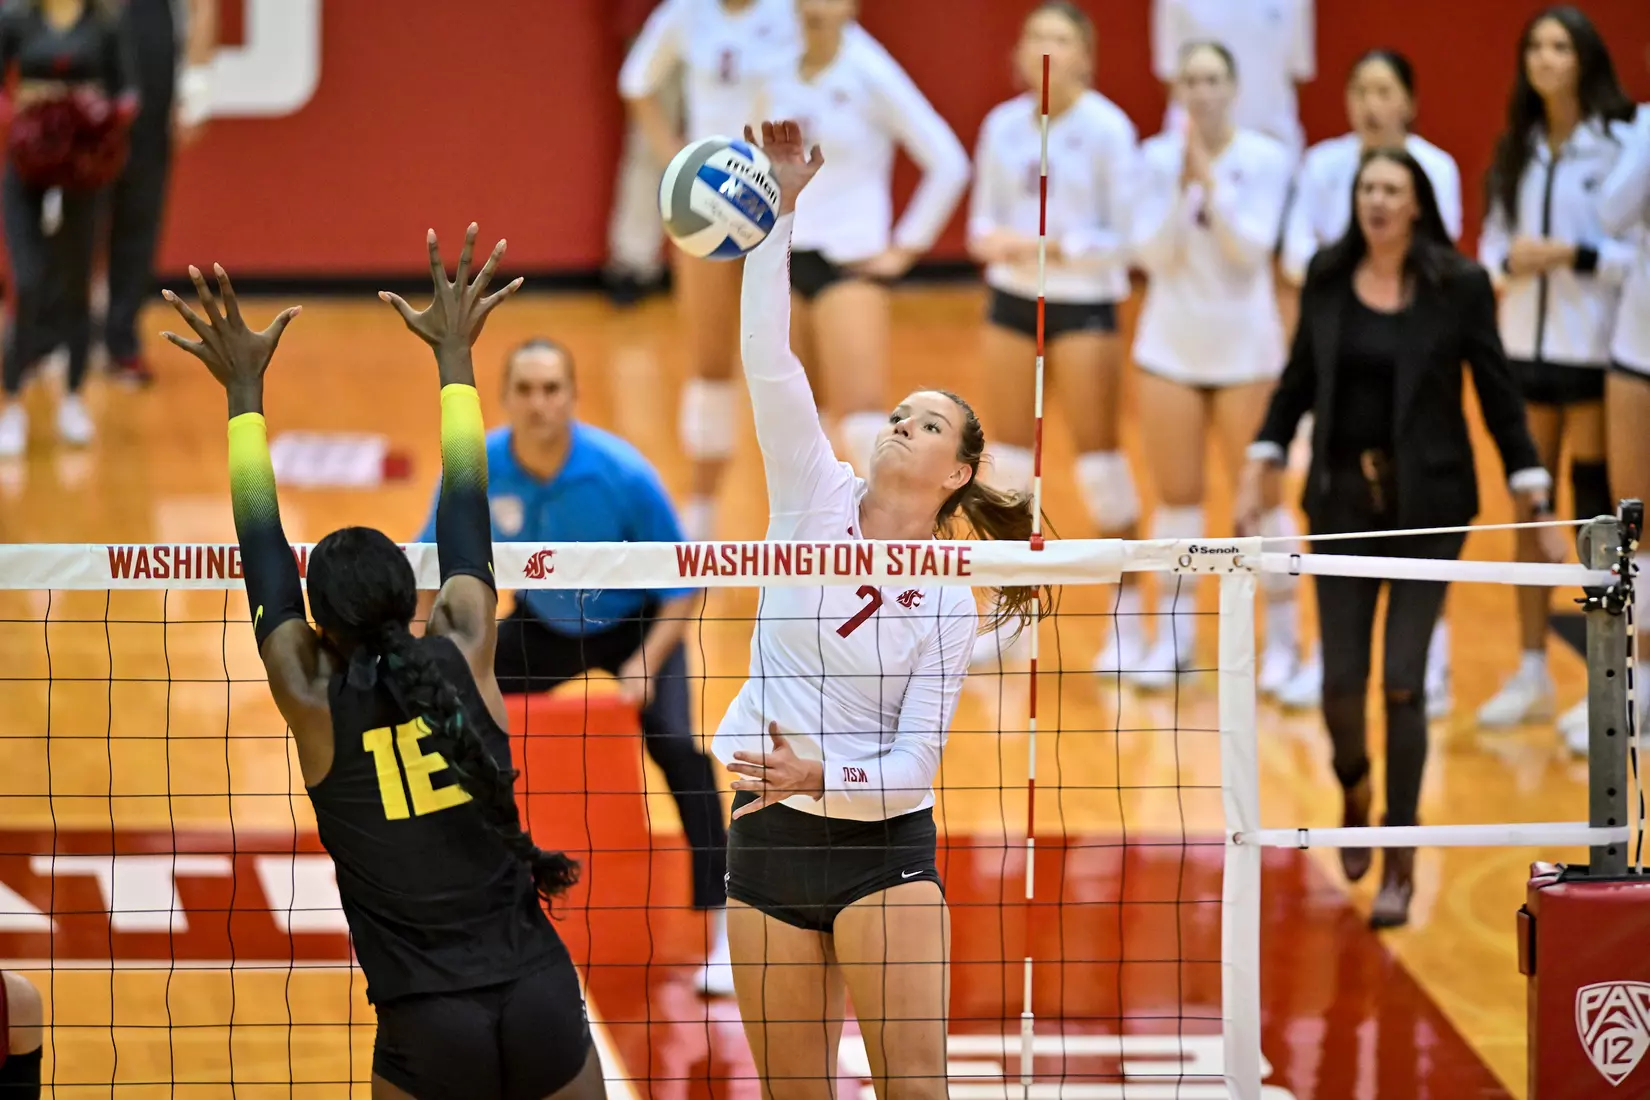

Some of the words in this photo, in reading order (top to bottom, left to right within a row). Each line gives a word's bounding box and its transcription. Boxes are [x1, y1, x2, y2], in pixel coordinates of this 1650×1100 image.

[726, 159, 778, 205] molten
[106, 545, 307, 579] WASHINGN
[675, 543, 874, 577] WASHINGTON
[886, 543, 972, 577] STATE
[1200, 546, 1240, 554] Senoh
[842, 766, 868, 783] WSU
[1580, 984, 1650, 1047] PAC
[1602, 1036, 1633, 1065] 12
